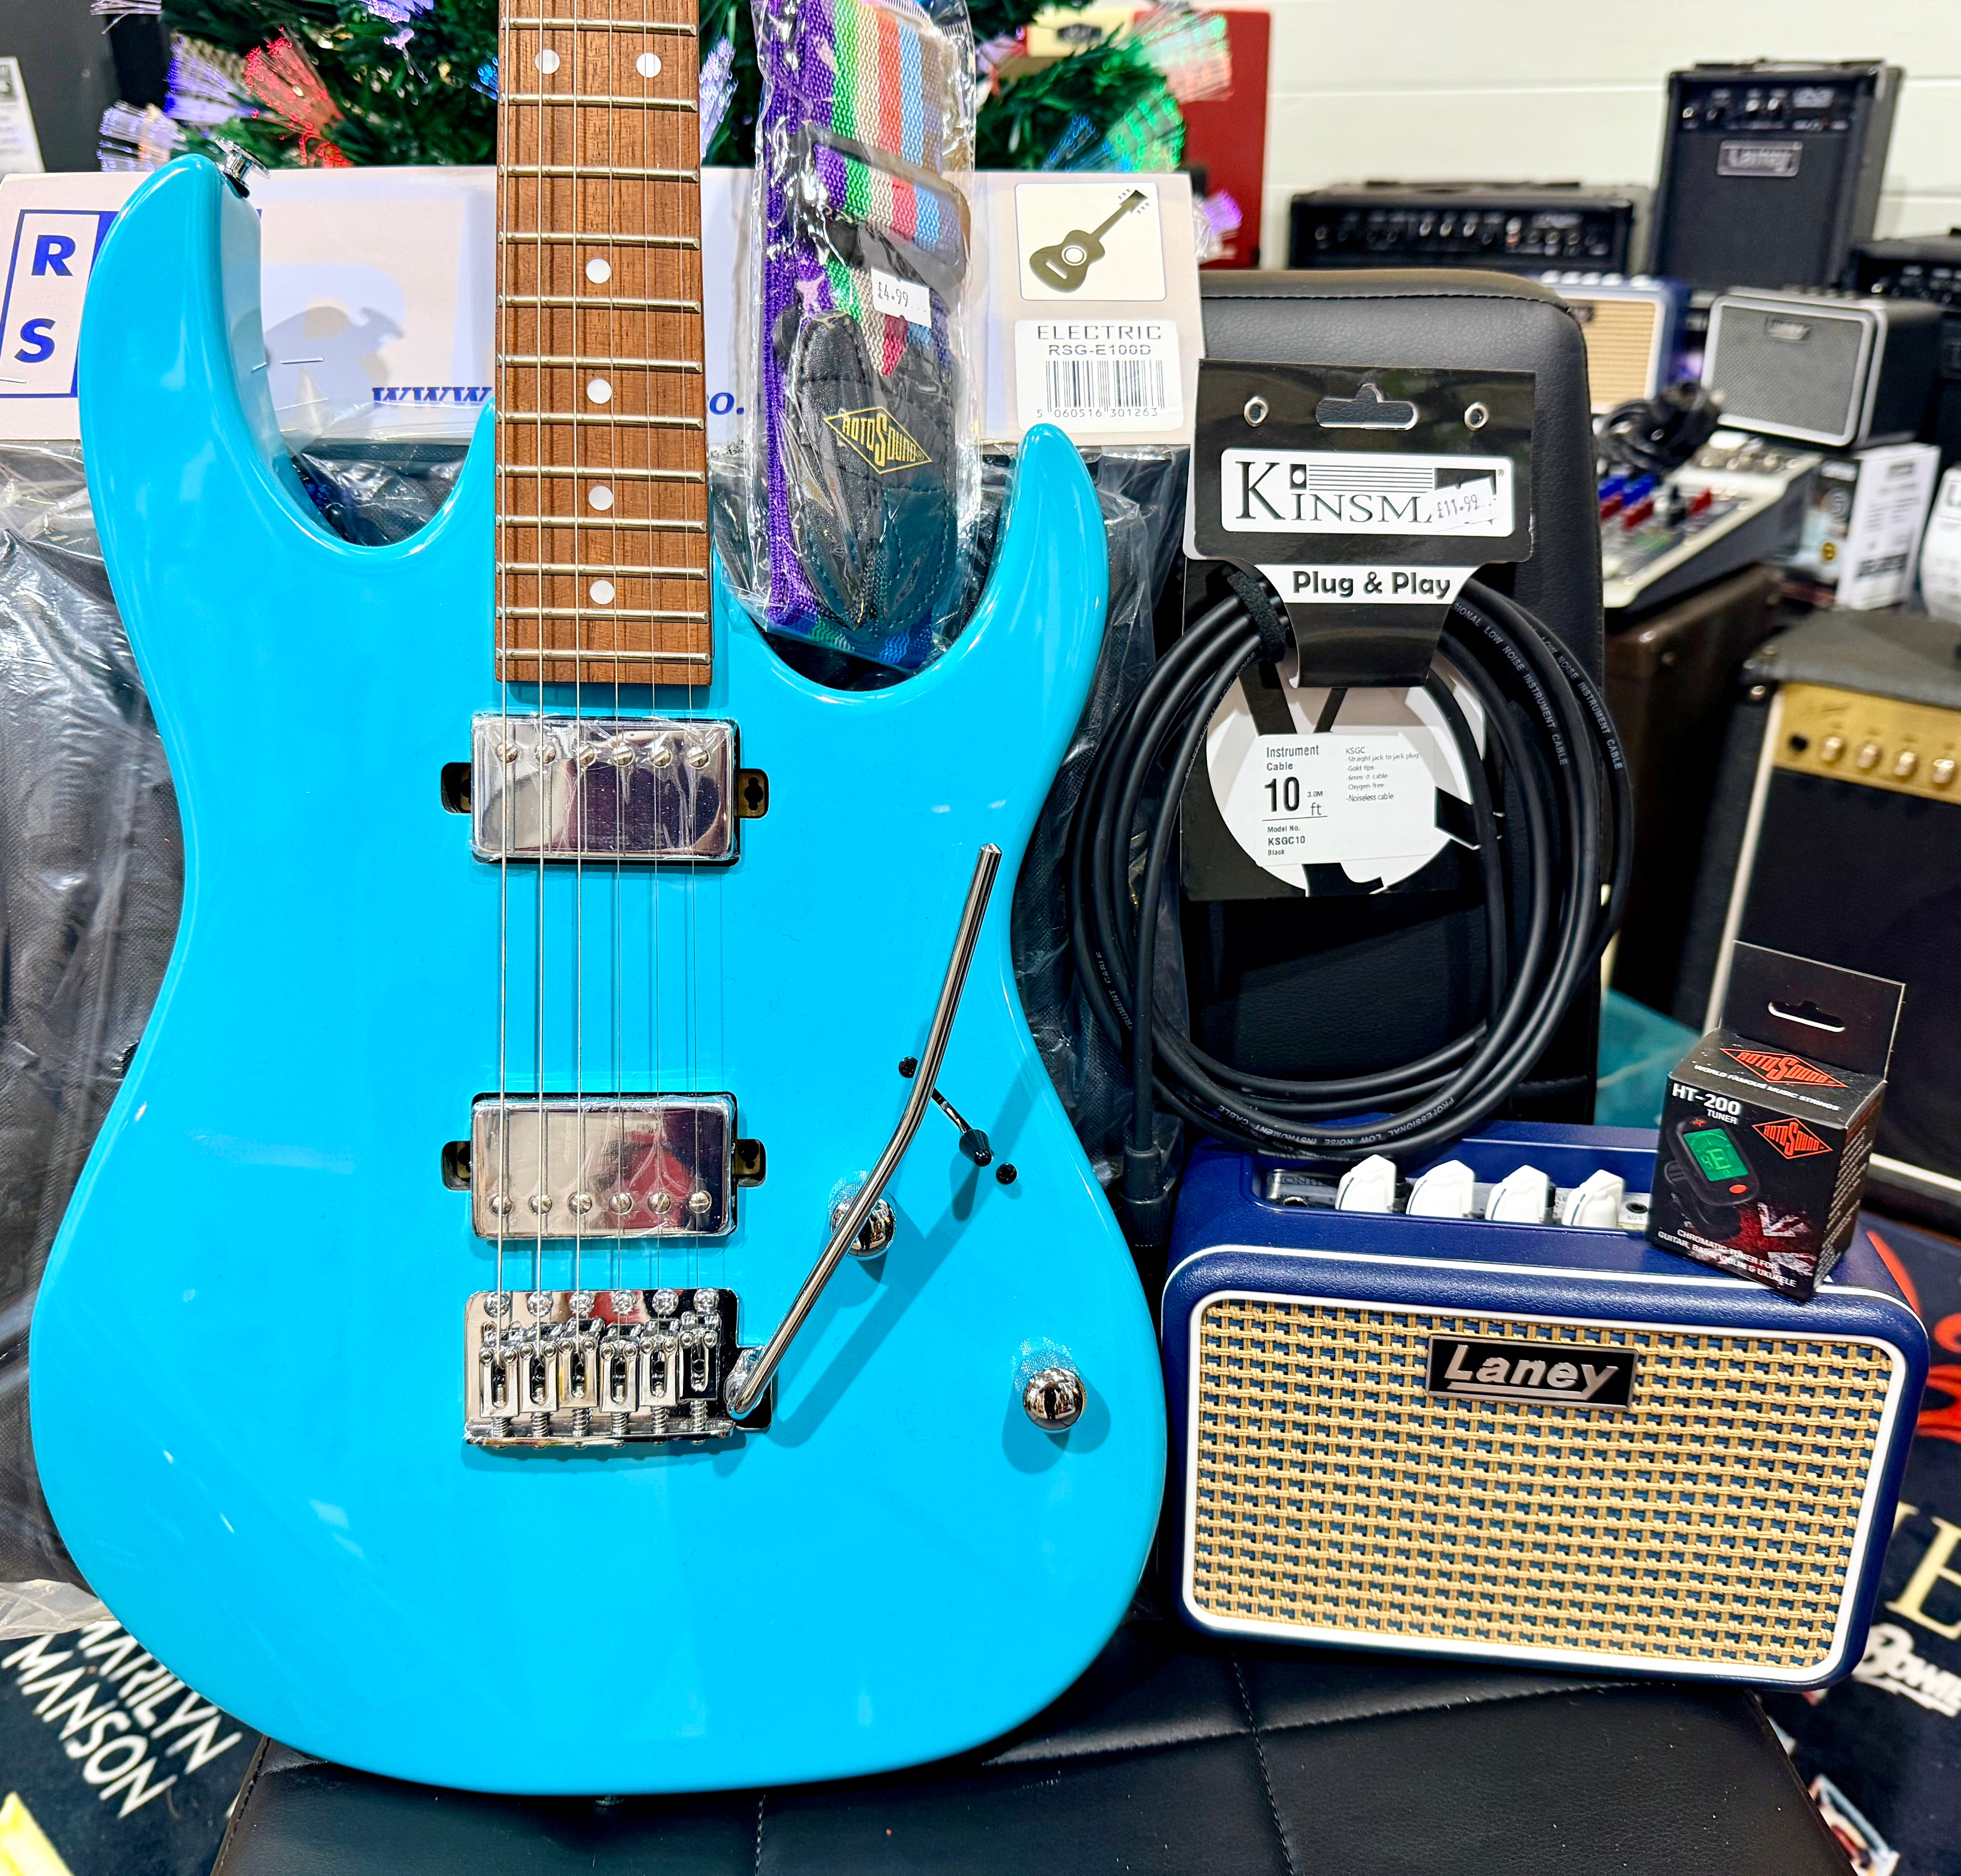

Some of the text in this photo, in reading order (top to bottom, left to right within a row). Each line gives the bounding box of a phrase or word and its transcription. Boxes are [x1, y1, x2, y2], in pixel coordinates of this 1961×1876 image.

[31, 235, 73, 276] R
[877, 282, 908, 307] £4.99
[14, 318, 56, 363] S
[1037, 325, 1162, 340] ELECTRIC
[1049, 344, 1151, 356] RSG-E100D
[1036, 407, 1158, 418] 5 060516 301263
[1235, 461, 1433, 524] KINSM
[1437, 494, 1478, 519] £11.99
[1292, 570, 1451, 600] Plug & Play
[1453, 603, 1569, 765] SIONAL LOW NOISE INSTRUMENT CABLE
[1557, 655, 1579, 681] NOISE
[1577, 680, 1612, 734] INSTRUMENT
[1606, 738, 1623, 770] CABLE
[1266, 744, 1319, 758] Instrument
[1371, 754, 1384, 762] jack
[1392, 753, 1405, 761] jack
[1266, 762, 1293, 771] Cable
[1264, 776, 1300, 812] 10
[1377, 792, 1394, 800] cable
[1310, 802, 1322, 816] ft
[1267, 836, 1306, 846] KSGC10
[1109, 989, 1133, 1031] TRUMENT
[1672, 1083, 1742, 1116] HT-200
[1694, 1064, 1841, 1111] WORLD FAMOUS MUSIC STRINGS
[1217, 1105, 1249, 1125] CABLE
[1387, 1097, 1454, 1136] PROFESSIONAL
[1706, 1108, 1739, 1125] TUNER
[1255, 1124, 1317, 1145] INSTRUMENT
[1359, 1133, 1382, 1143] LOW
[1676, 1229, 1779, 1271] CHROMATIC TUNER FOR
[1719, 1253, 1748, 1270] VIOLIN
[1748, 1264, 1757, 1273] &
[1757, 1267, 1798, 1287] UKULELE
[1443, 1344, 1619, 1401] Laney
[0, 1633, 178, 1820] MANSON
